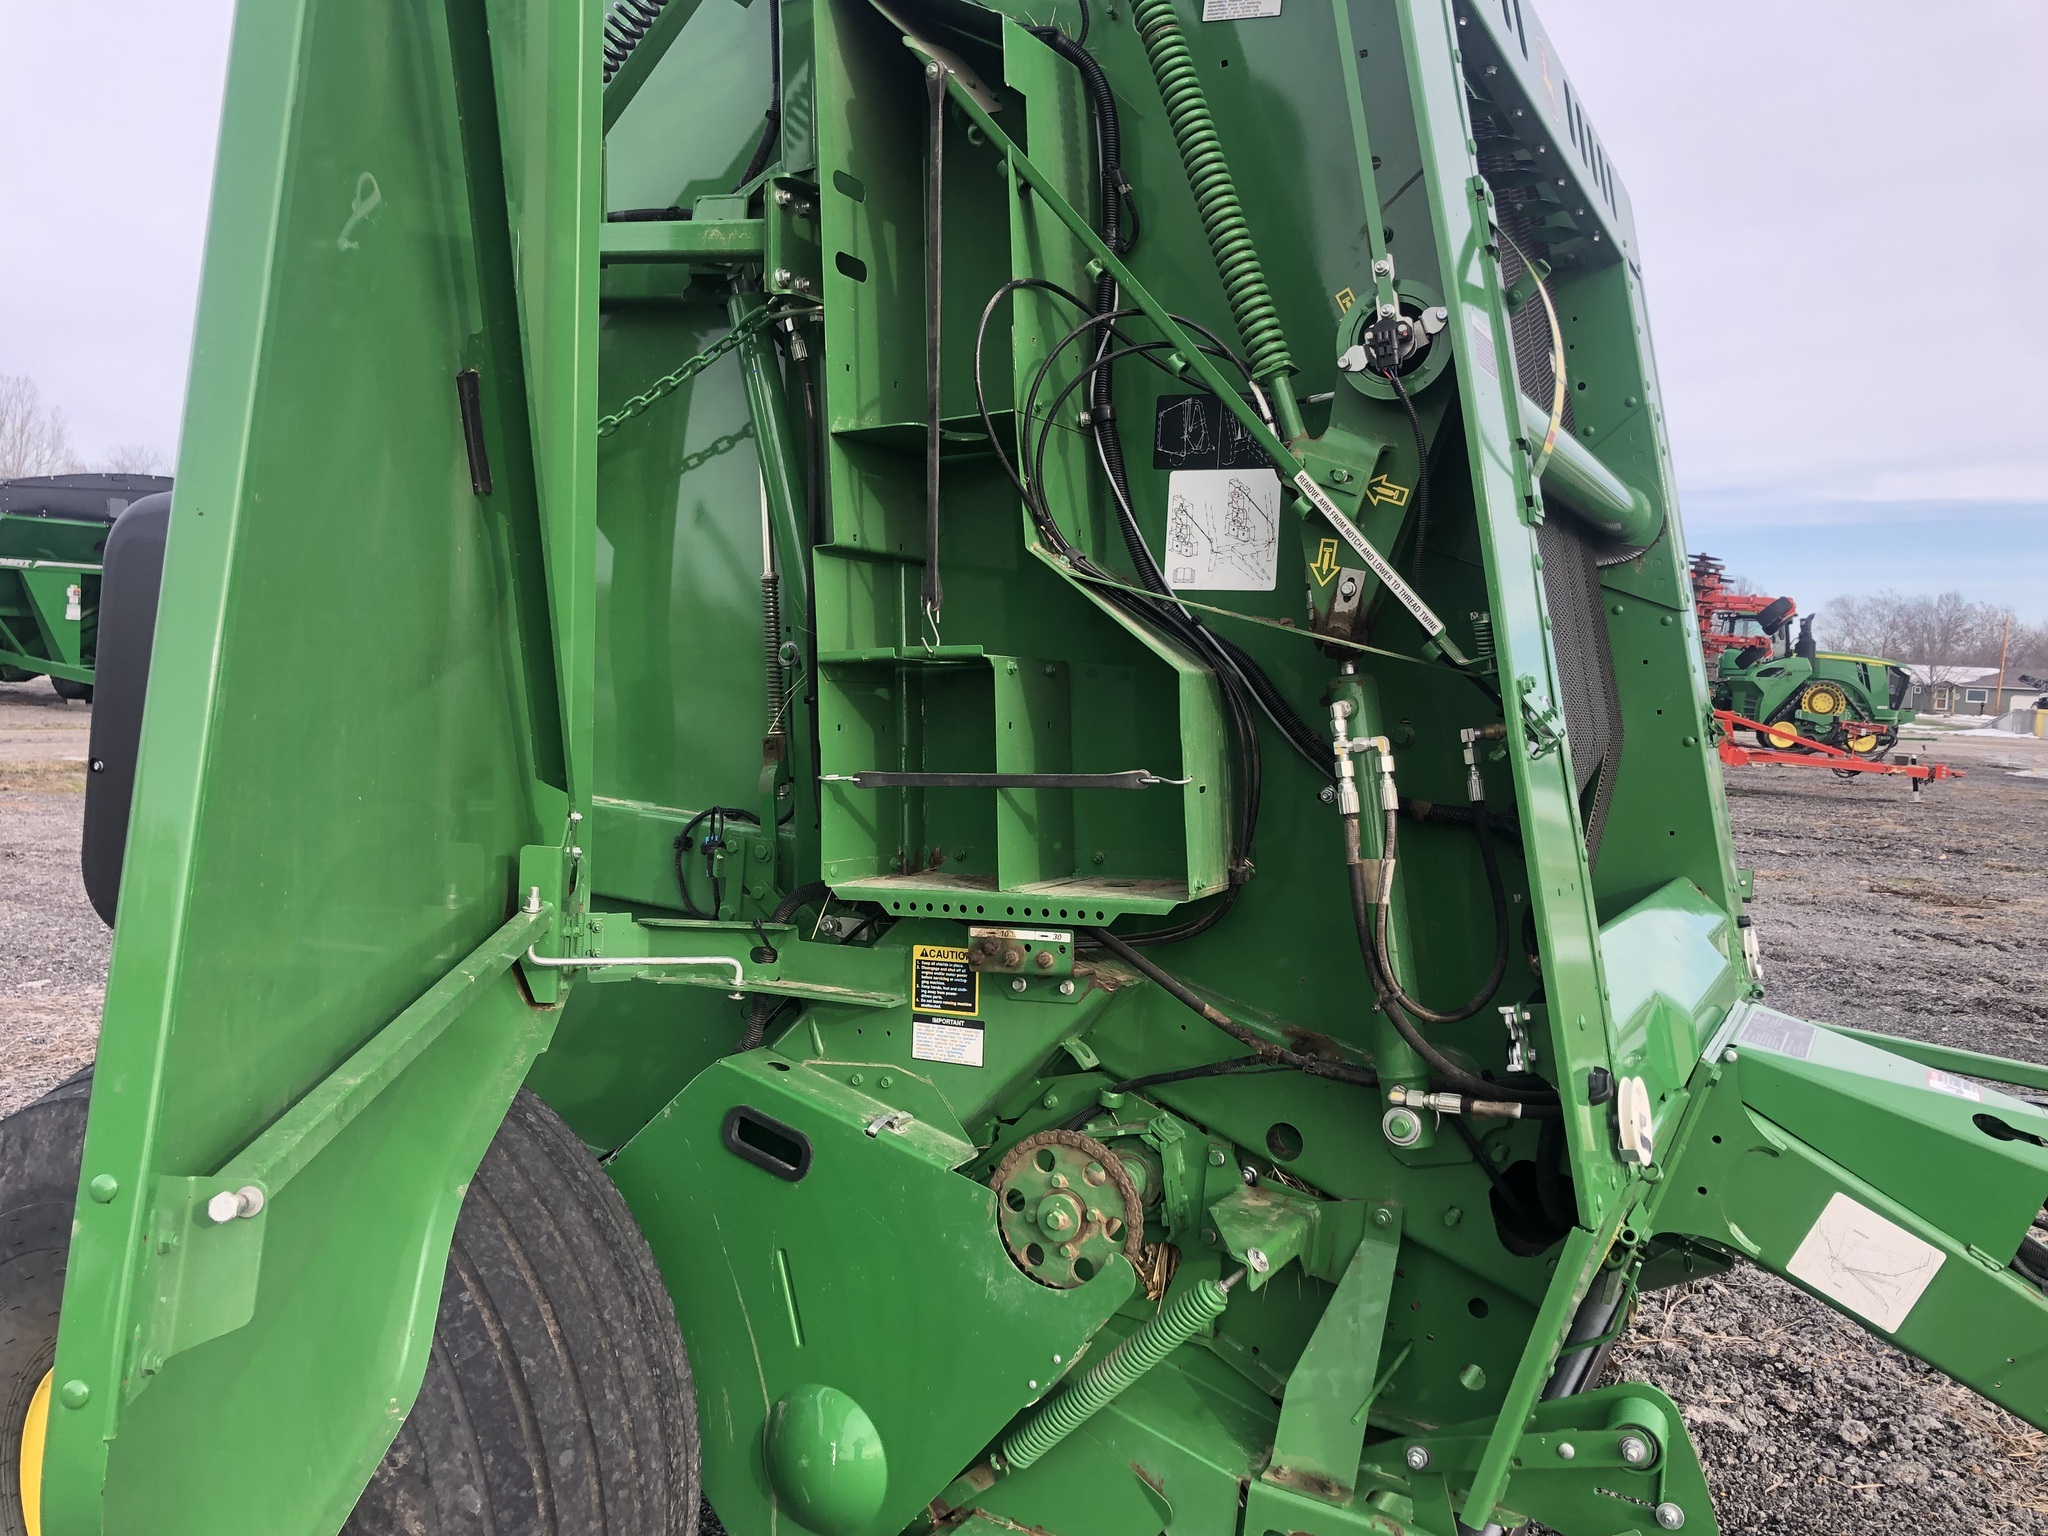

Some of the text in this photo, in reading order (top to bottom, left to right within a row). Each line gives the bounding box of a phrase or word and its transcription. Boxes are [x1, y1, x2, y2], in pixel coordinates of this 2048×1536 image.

[1298, 474, 1438, 632] REMOVE ARM FROM NOTCH AND LOWER TO THREAD TWINE
[932, 1017, 965, 1027] IMPORTANT
